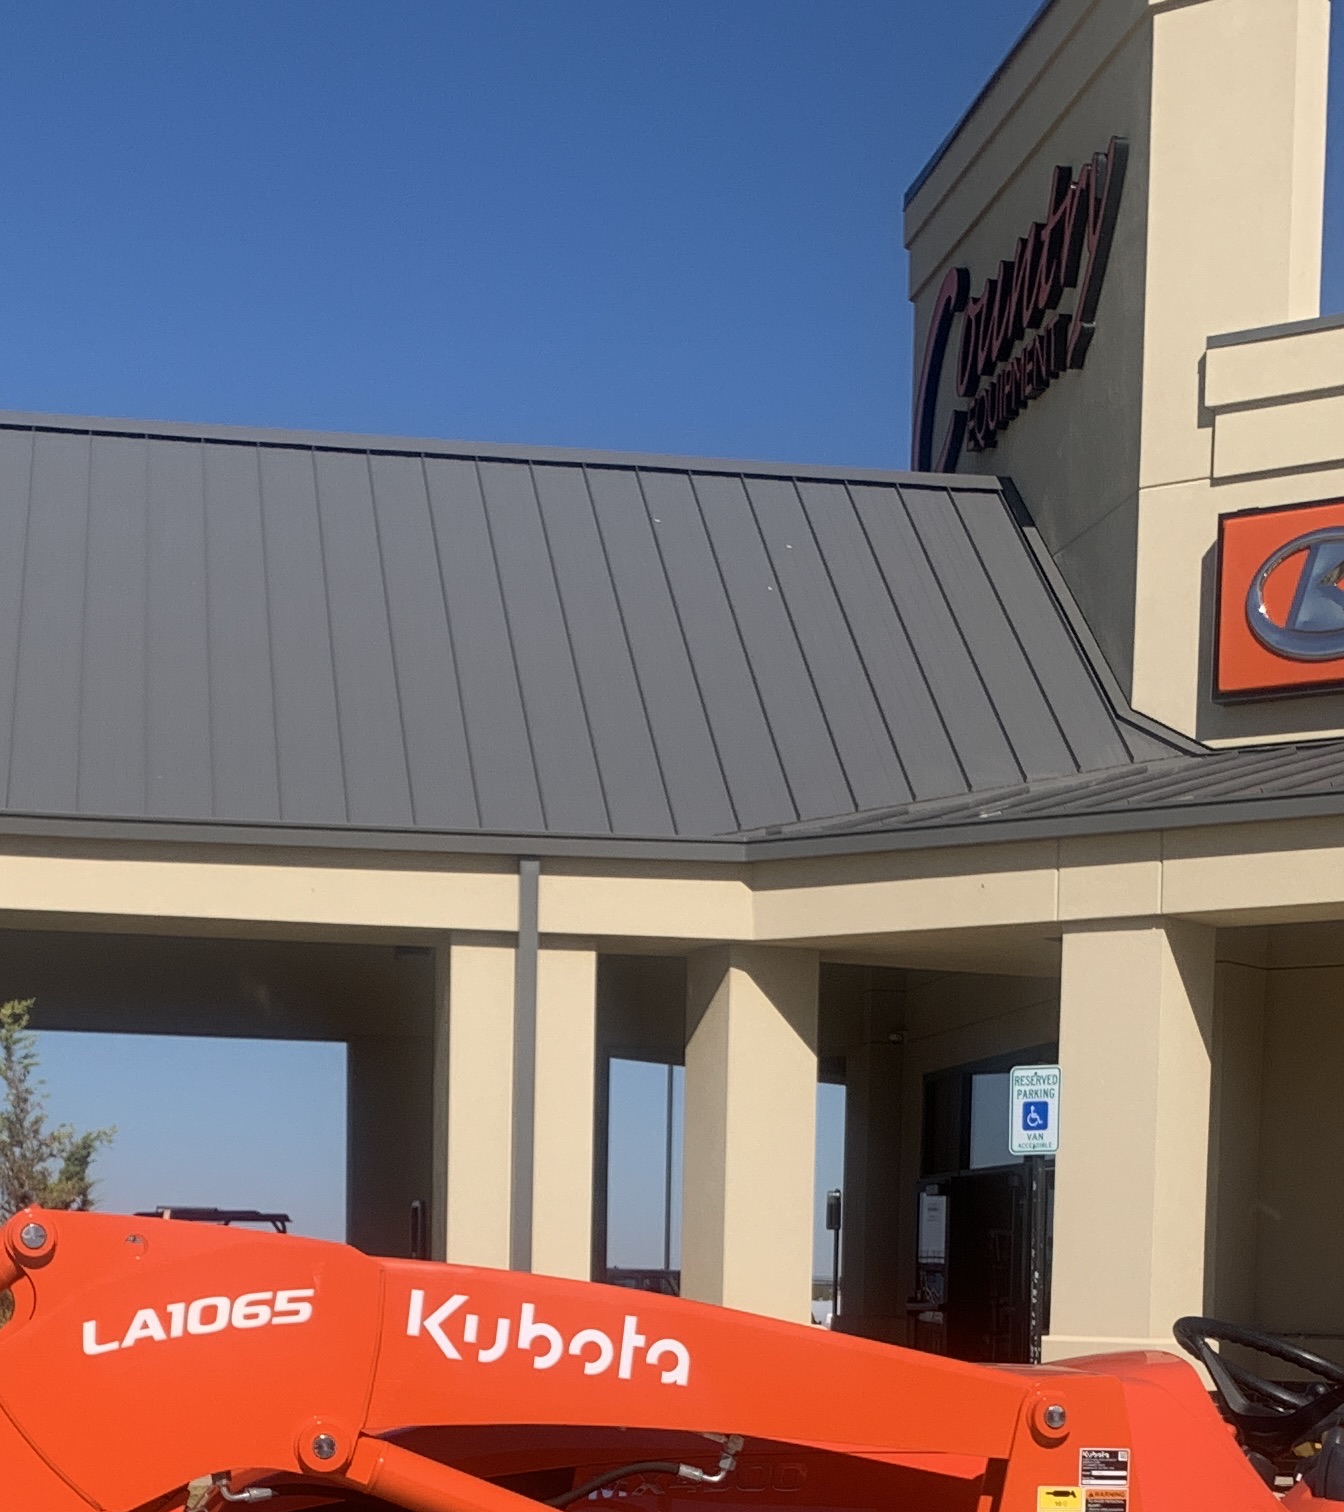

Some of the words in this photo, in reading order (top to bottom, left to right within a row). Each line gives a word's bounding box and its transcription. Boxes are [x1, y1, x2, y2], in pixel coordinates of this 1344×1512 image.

[912, 136, 1129, 472] Country
[966, 313, 1072, 452] EQUIPMENT
[1014, 1074, 1058, 1087] RESERVED
[1016, 1088, 1056, 1100] PARKING
[1017, 1141, 1053, 1149] ACCESSIBLE
[1026, 1132, 1044, 1142] VAN
[82, 1287, 315, 1356] LA1065
[406, 1289, 692, 1387] Kubota
